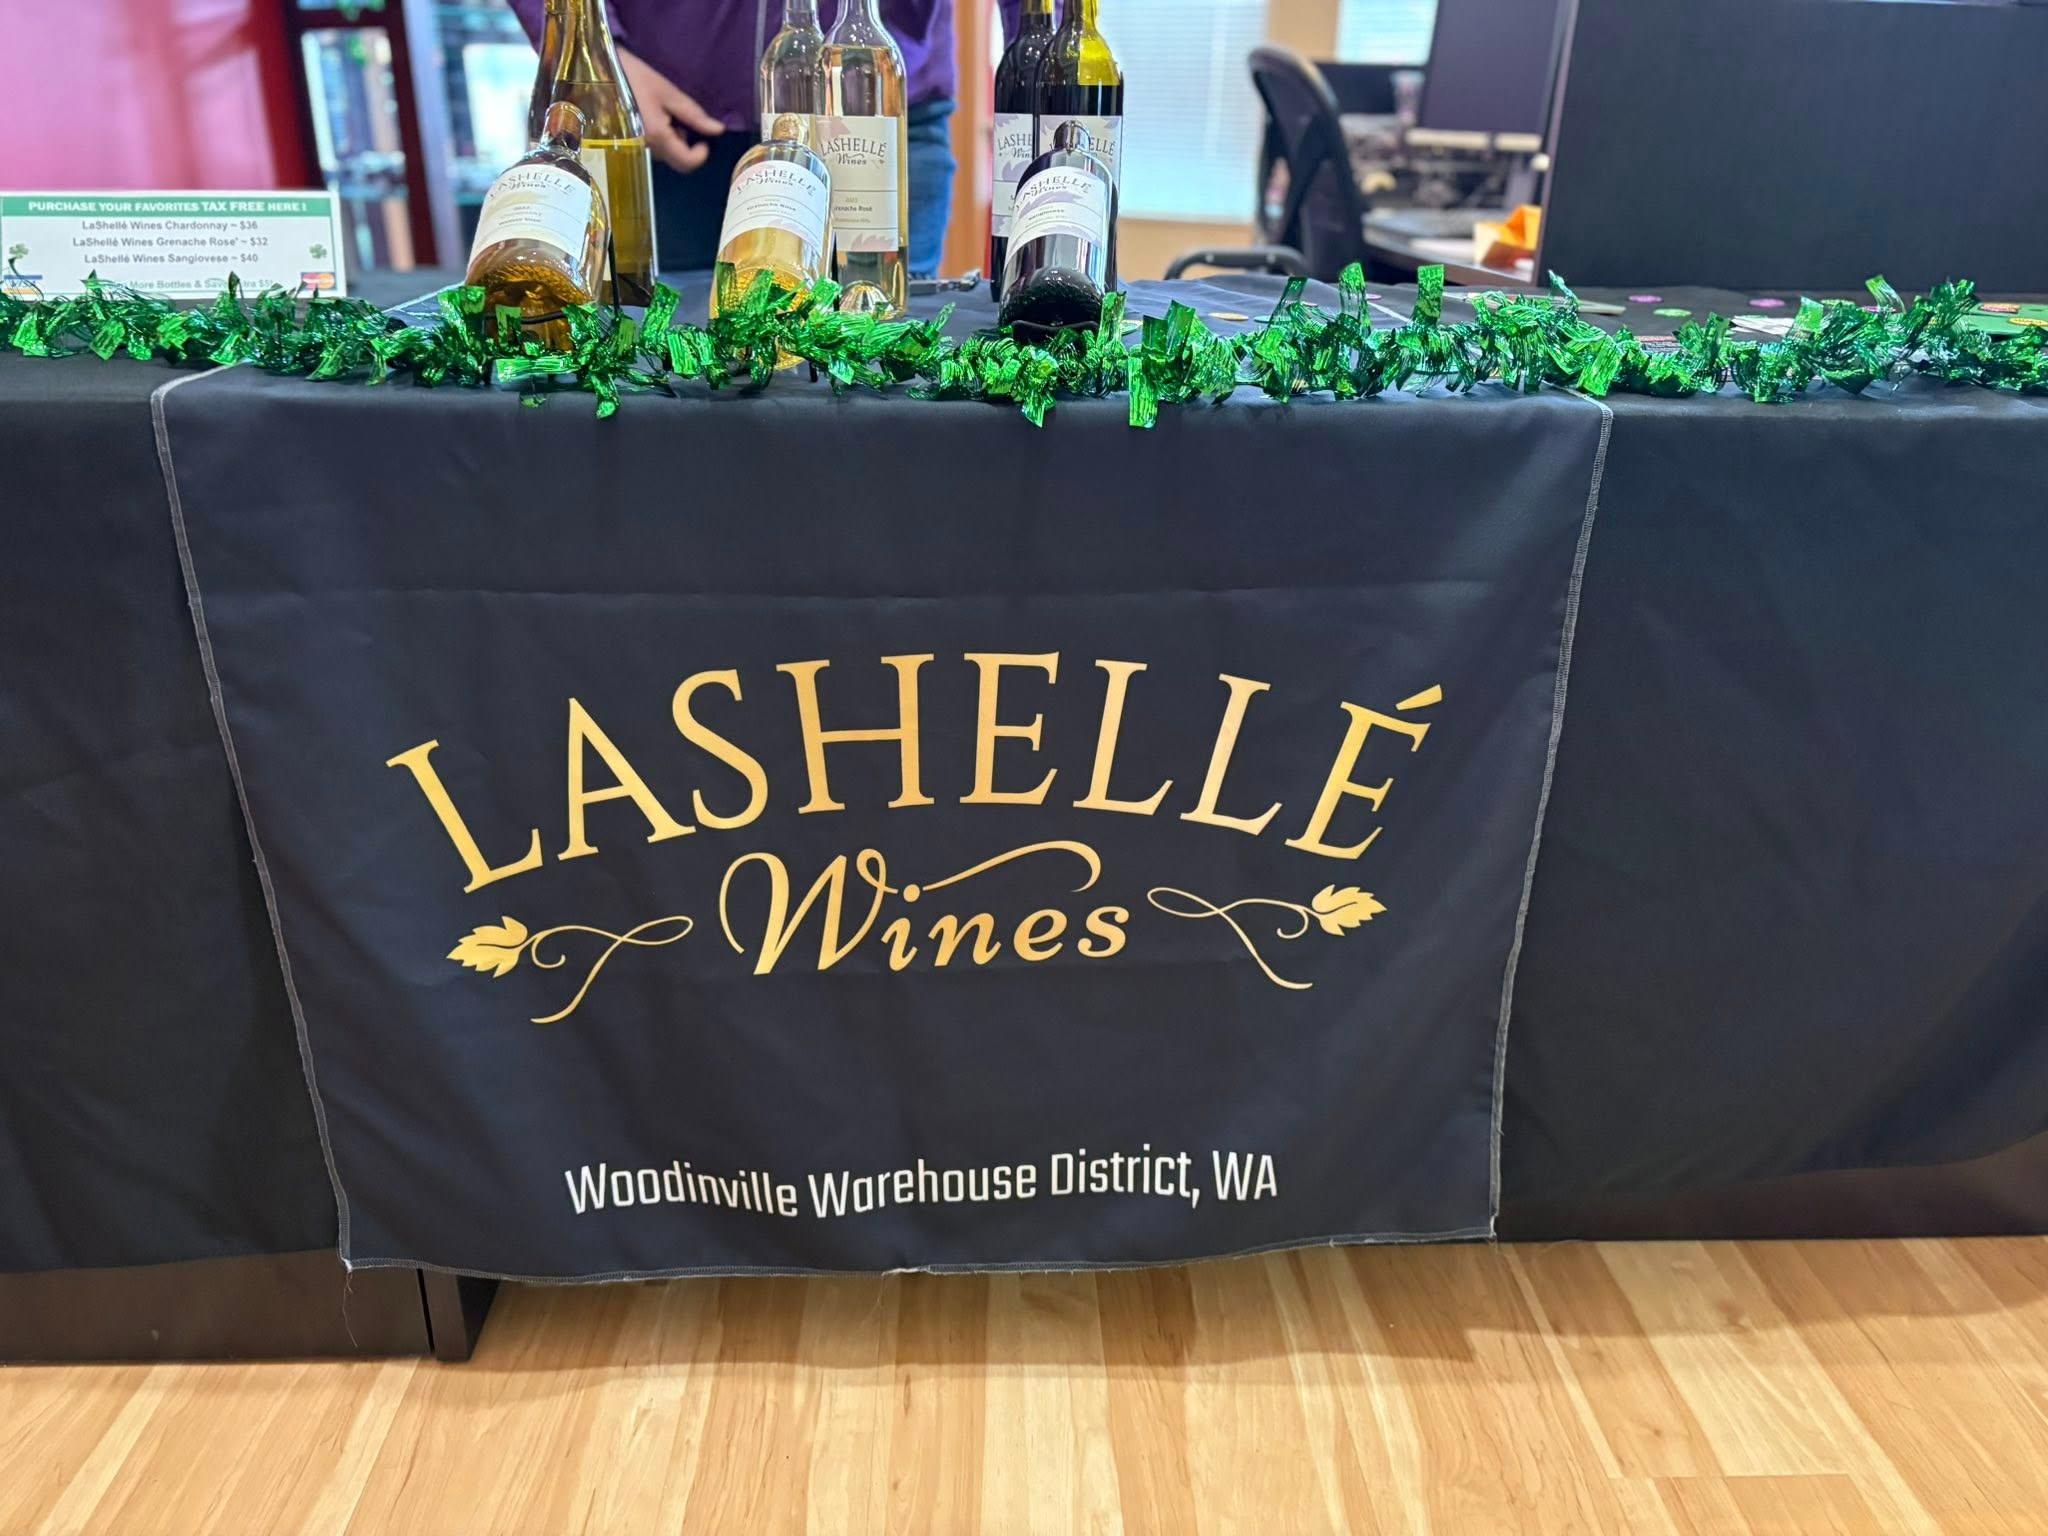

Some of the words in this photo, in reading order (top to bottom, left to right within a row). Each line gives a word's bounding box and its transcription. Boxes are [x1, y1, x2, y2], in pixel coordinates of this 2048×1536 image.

[837, 152, 868, 165] Wines
[28, 201, 97, 212] PURCHASE
[99, 202, 132, 212] YOUR
[134, 202, 200, 212] FAVORITES
[201, 201, 227, 212] TAX
[229, 201, 265, 212] FREE
[267, 202, 299, 212] HERE
[82, 220, 127, 230] LaShellé
[129, 220, 163, 230] Wines
[165, 220, 228, 232] Chardonnay
[240, 220, 258, 230] $36
[72, 236, 119, 247] LaShellé
[121, 237, 153, 247] Wines
[156, 236, 207, 247] Grenache
[250, 237, 268, 246] $32
[84, 253, 130, 264] LaShellé
[133, 253, 165, 263] Wines
[168, 253, 228, 264] Sangiovese
[240, 253, 258, 263] $40
[130, 280, 154, 289] More
[157, 280, 192, 289] Bottles
[194, 280, 203, 289] &
[386, 652, 1442, 893] LASHELLÉ
[720, 841, 1129, 974] Wines
[565, 1160, 797, 1216] Woodinville
[808, 1158, 1036, 1217] Warehouse
[1052, 1143, 1199, 1209] District,
[1213, 1151, 1276, 1200] WA
